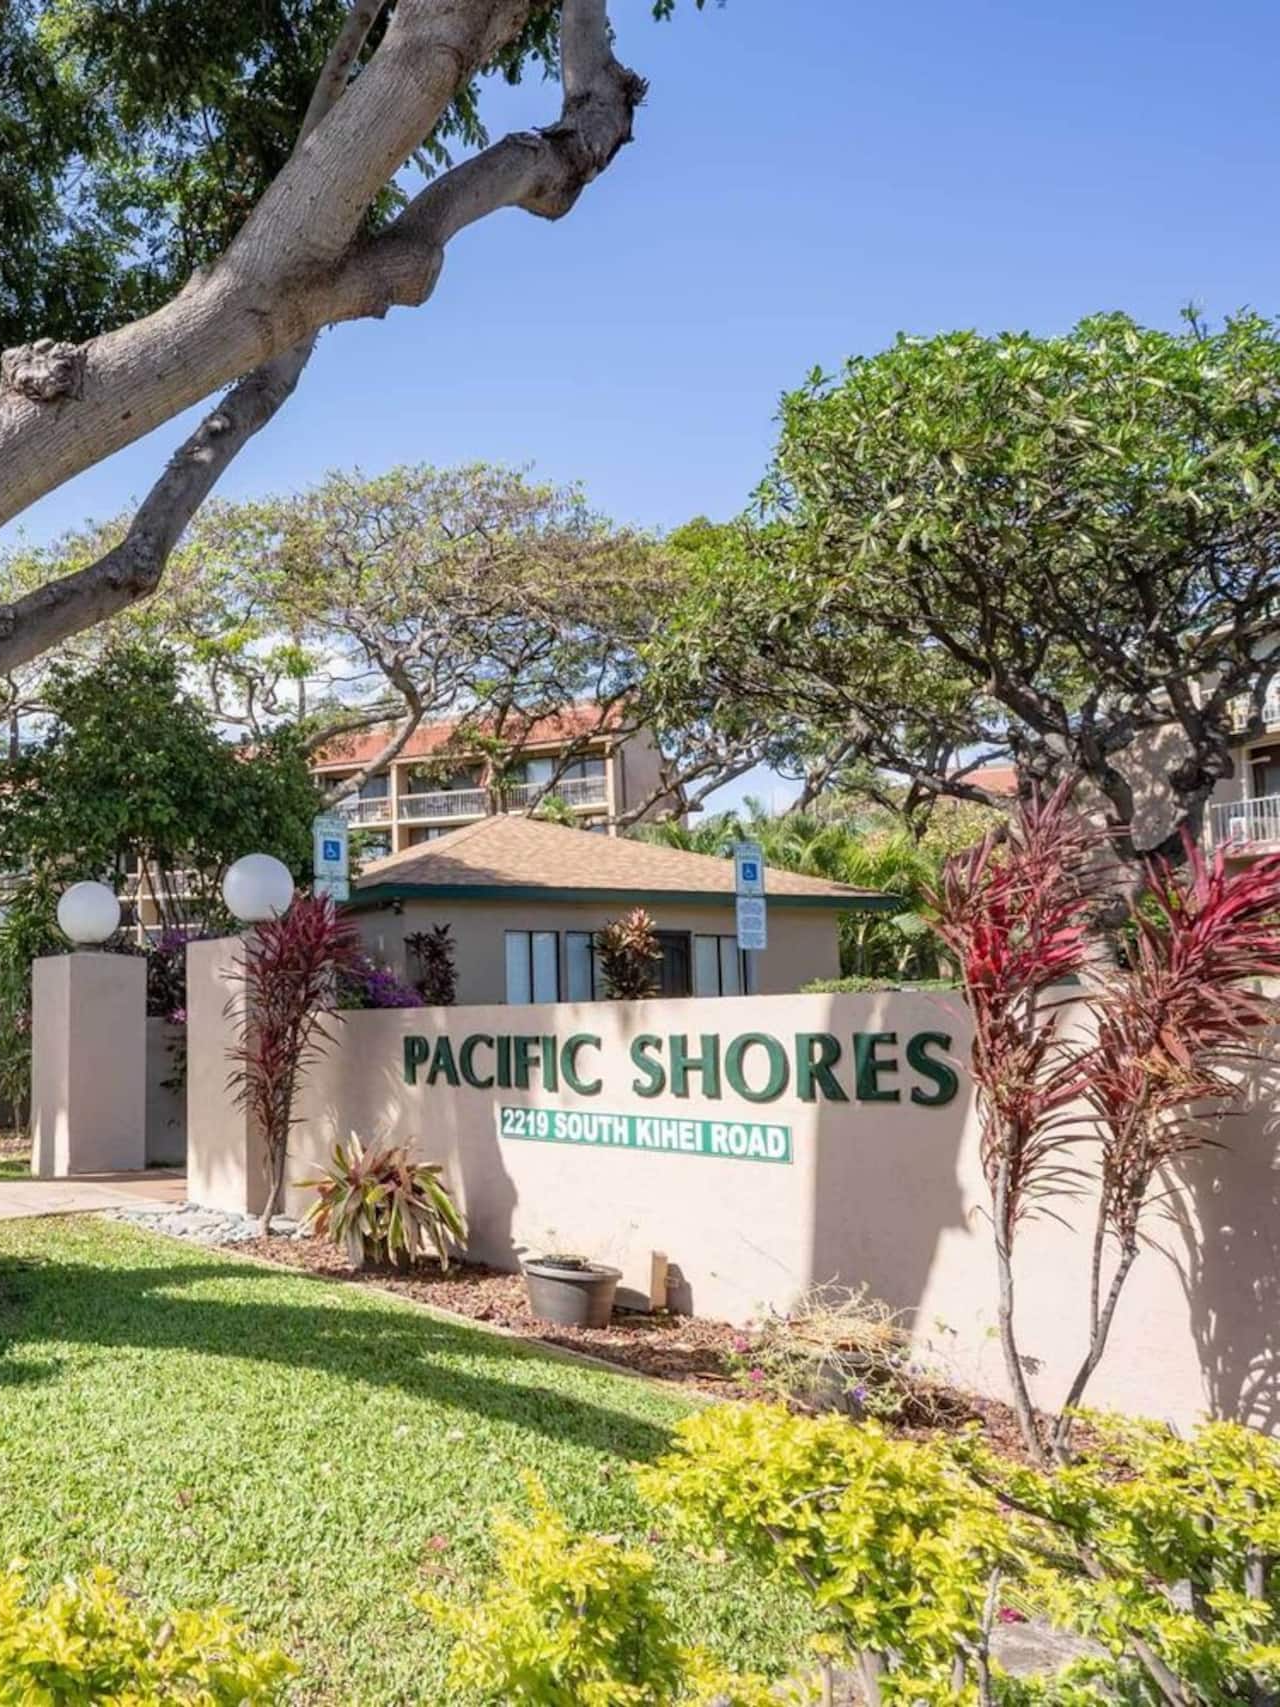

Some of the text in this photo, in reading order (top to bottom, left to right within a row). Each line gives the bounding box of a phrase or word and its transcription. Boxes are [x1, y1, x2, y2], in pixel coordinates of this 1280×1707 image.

[403, 1032, 959, 1106] PACIFIC SHORES
[503, 1109, 786, 1159] 2219 SOUTH KIHEI ROAD
